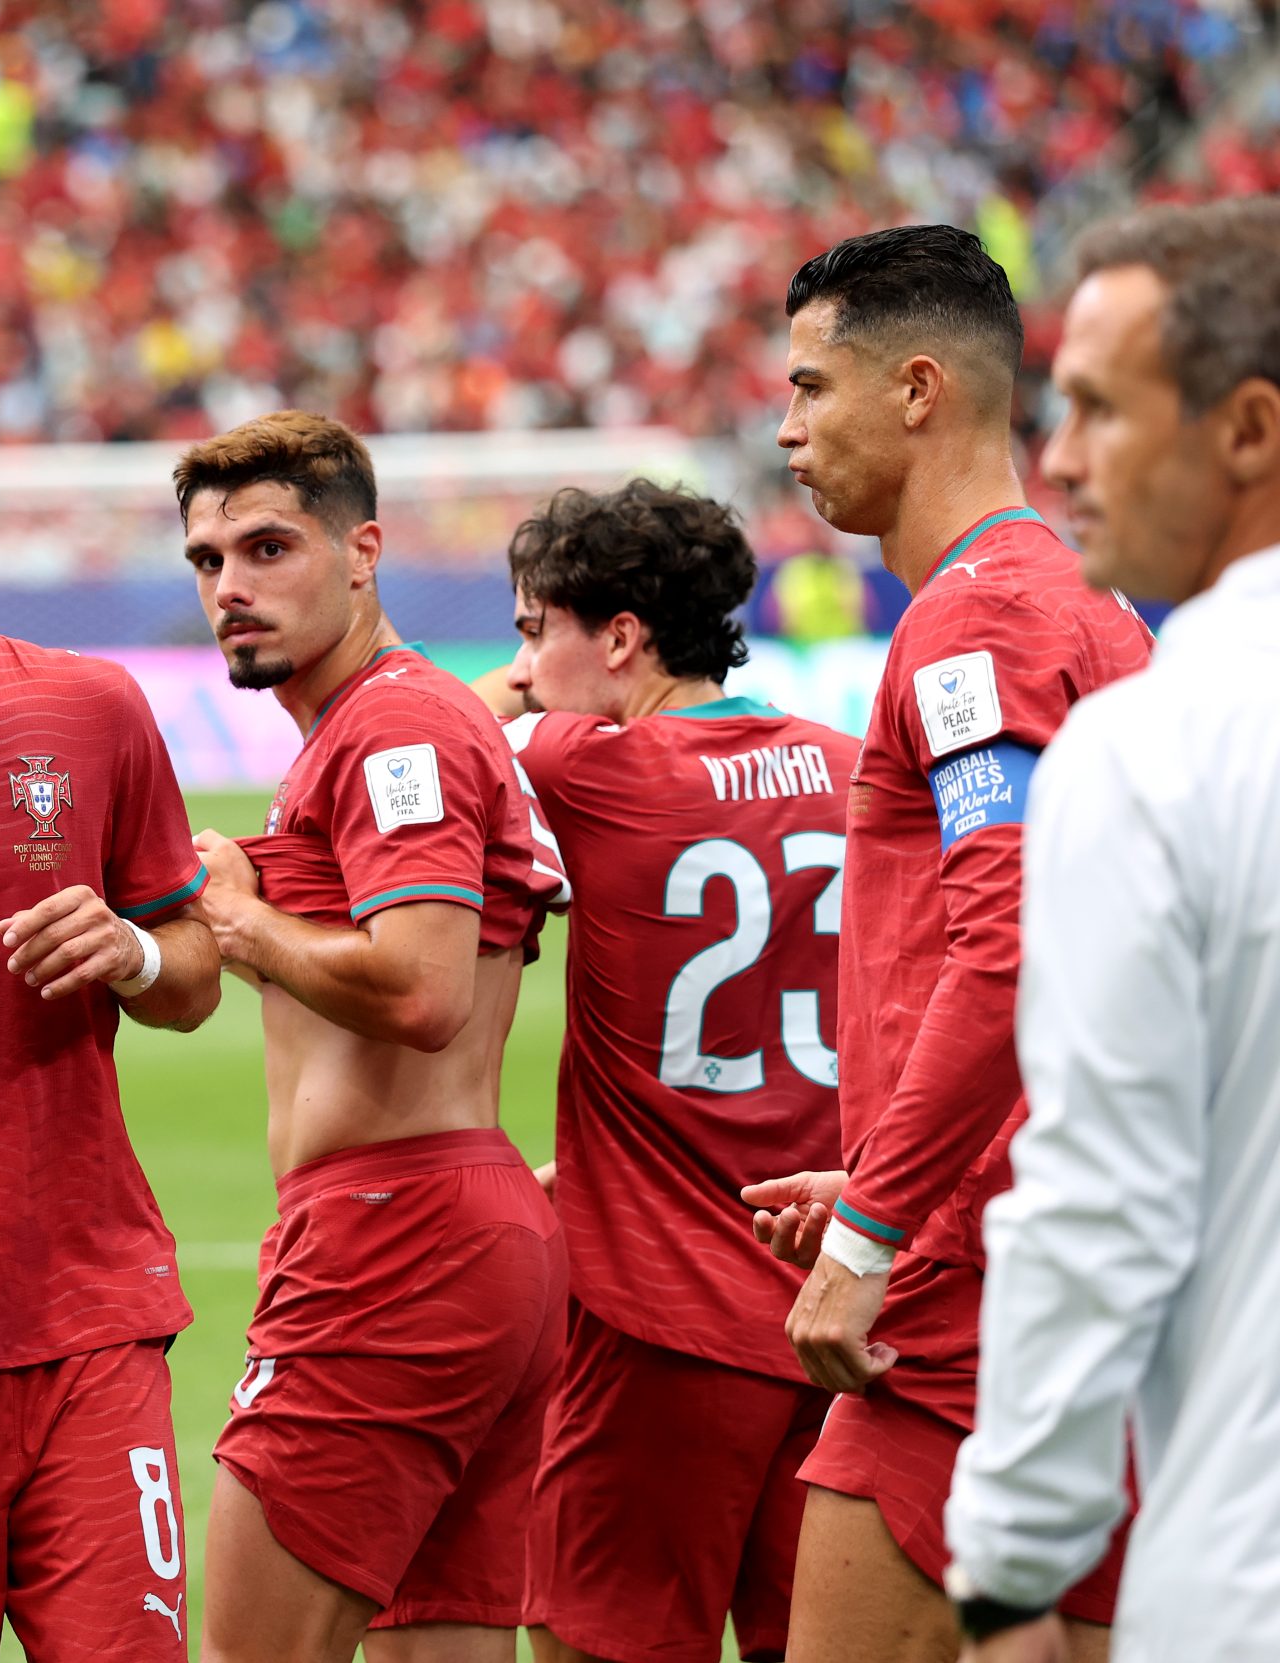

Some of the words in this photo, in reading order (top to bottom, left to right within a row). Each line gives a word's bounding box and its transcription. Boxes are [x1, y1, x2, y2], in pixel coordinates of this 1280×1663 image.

[936, 697, 961, 716] Unite
[960, 691, 977, 707] For
[942, 706, 978, 731] PEACE
[952, 726, 971, 738] FIFA
[699, 744, 835, 802] VITINHA
[933, 749, 1000, 792] FOOTBALL
[385, 782, 405, 797] Unite
[407, 779, 420, 792] For
[939, 763, 1006, 811] UNITES
[390, 793, 420, 810] PEACE
[942, 808, 959, 832] the
[958, 783, 1013, 816] World
[957, 813, 983, 831] FIFA
[20, 854, 27, 863] 17
[29, 853, 52, 862] JUNHO
[29, 862, 61, 871] HOUSTON
[657, 830, 848, 1094] 23
[127, 1446, 181, 1581] 8
